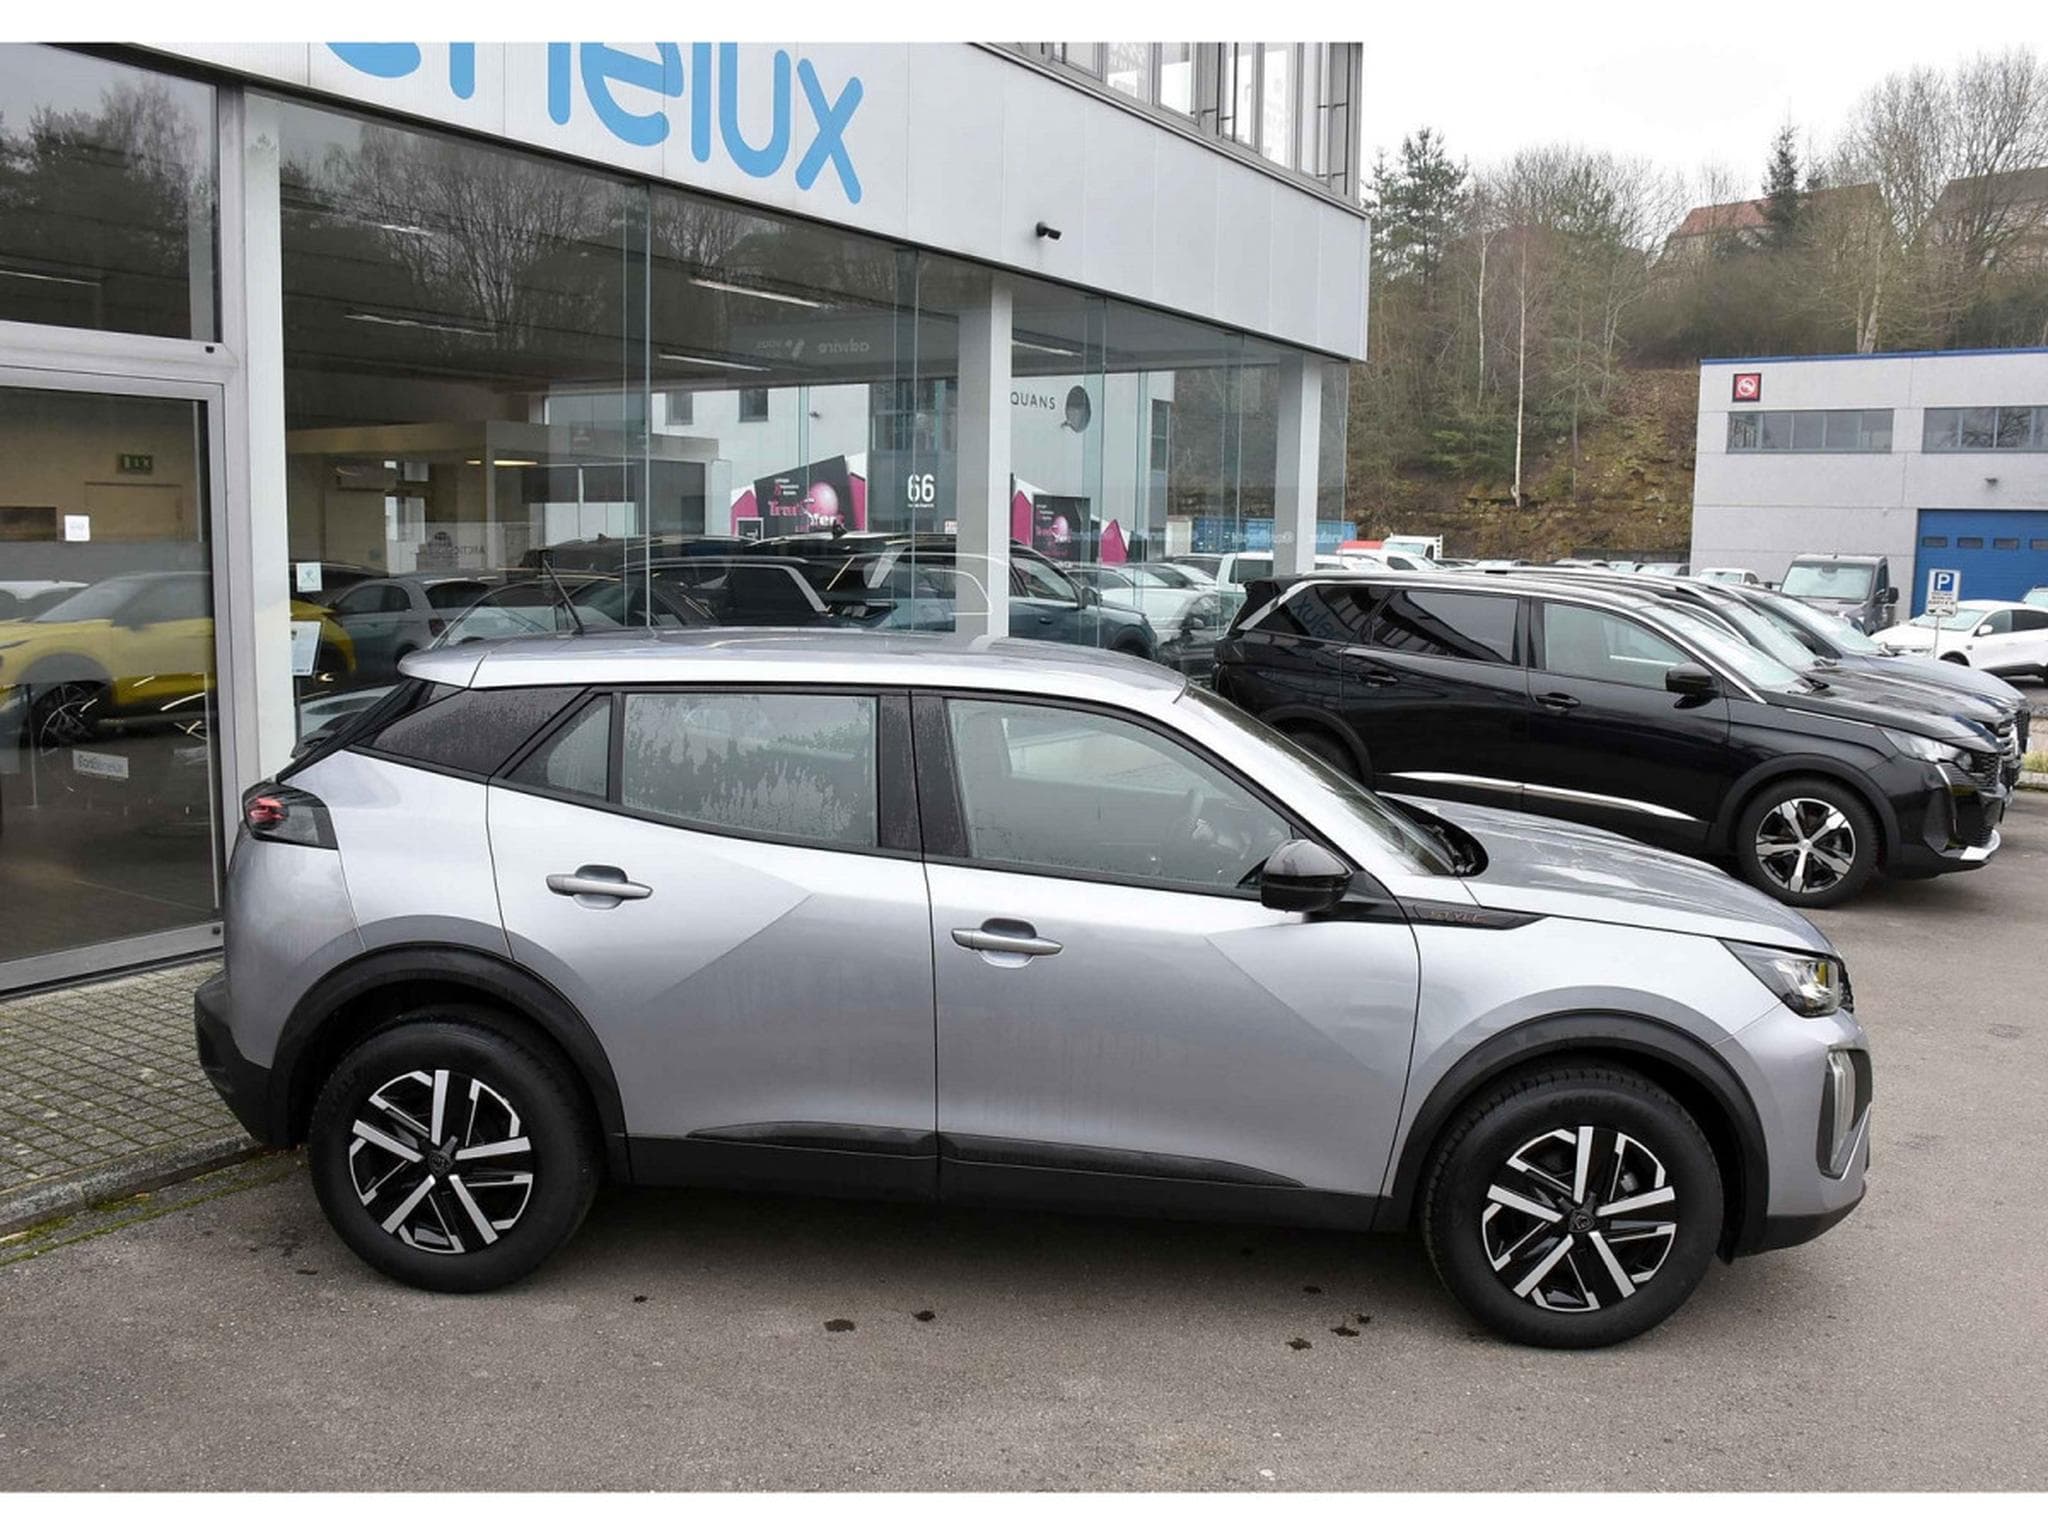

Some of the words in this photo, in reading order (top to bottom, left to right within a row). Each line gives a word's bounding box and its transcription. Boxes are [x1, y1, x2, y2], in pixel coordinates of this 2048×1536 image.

[325, 43, 863, 204] elux
[908, 473, 935, 502] 66
[1937, 573, 1951, 590] P
